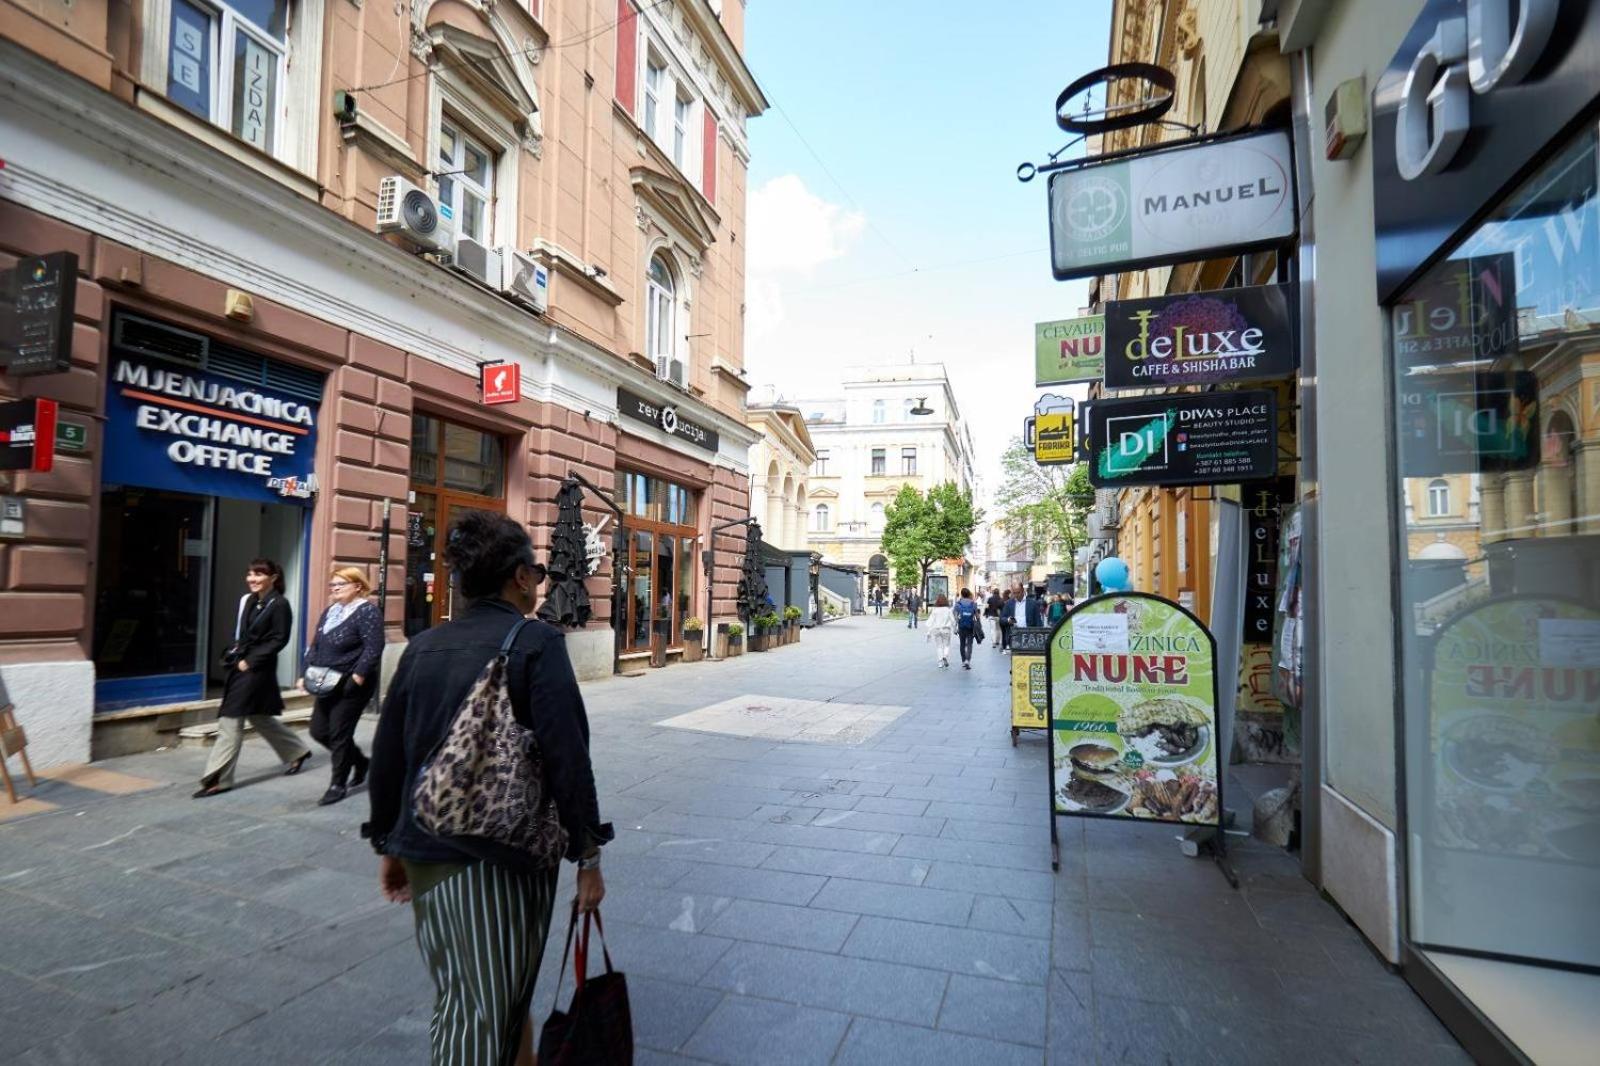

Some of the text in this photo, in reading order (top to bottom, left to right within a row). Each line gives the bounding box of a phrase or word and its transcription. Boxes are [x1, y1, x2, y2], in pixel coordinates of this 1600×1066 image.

[1144, 178, 1280, 215] MANUEL
[1125, 310, 1266, 360] deLuxe
[1132, 356, 1256, 377] CAFFE & SHISHA BAR
[1193, 418, 1255, 429] BEAUTY STUDIO
[1227, 405, 1267, 417] PLACE
[136, 405, 296, 455] EXCHANGE
[1120, 430, 1154, 456] DI
[167, 440, 272, 476] OFFICE
[1073, 654, 1189, 684] NUNE
